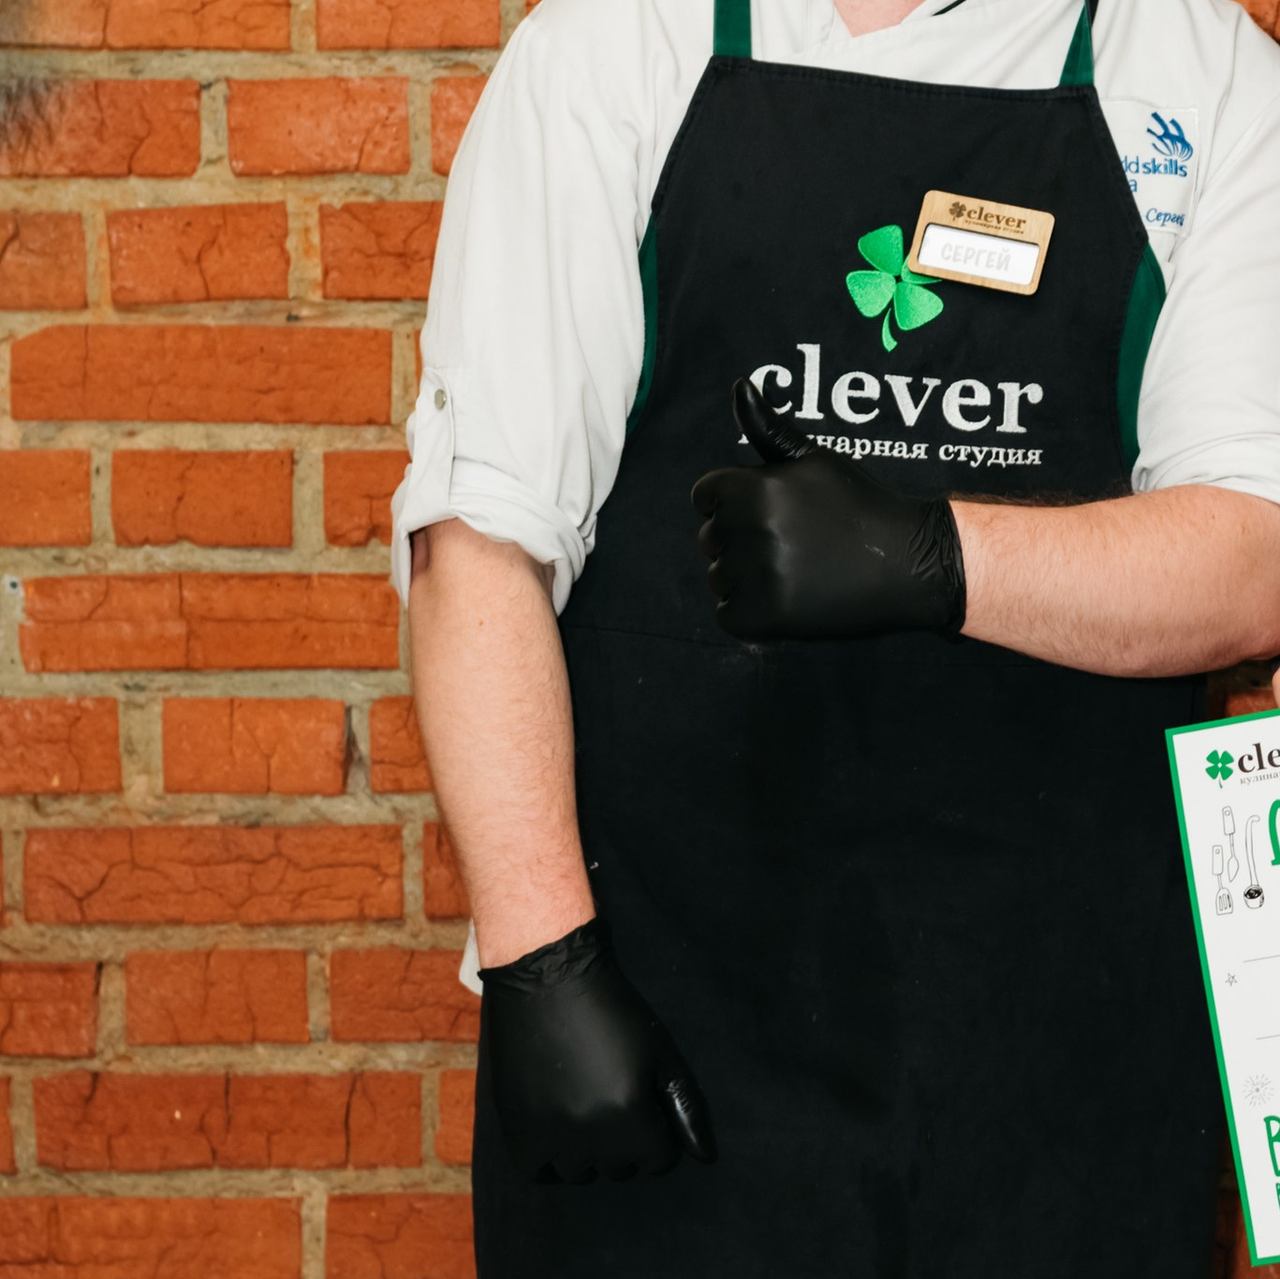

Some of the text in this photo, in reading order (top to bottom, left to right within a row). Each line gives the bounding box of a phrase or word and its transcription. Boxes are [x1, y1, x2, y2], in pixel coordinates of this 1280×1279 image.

[967, 206, 1026, 228] clever
[941, 242, 1012, 272] СЕРГЕЙ
[750, 343, 1043, 433] clever
[939, 443, 1043, 468] студия
